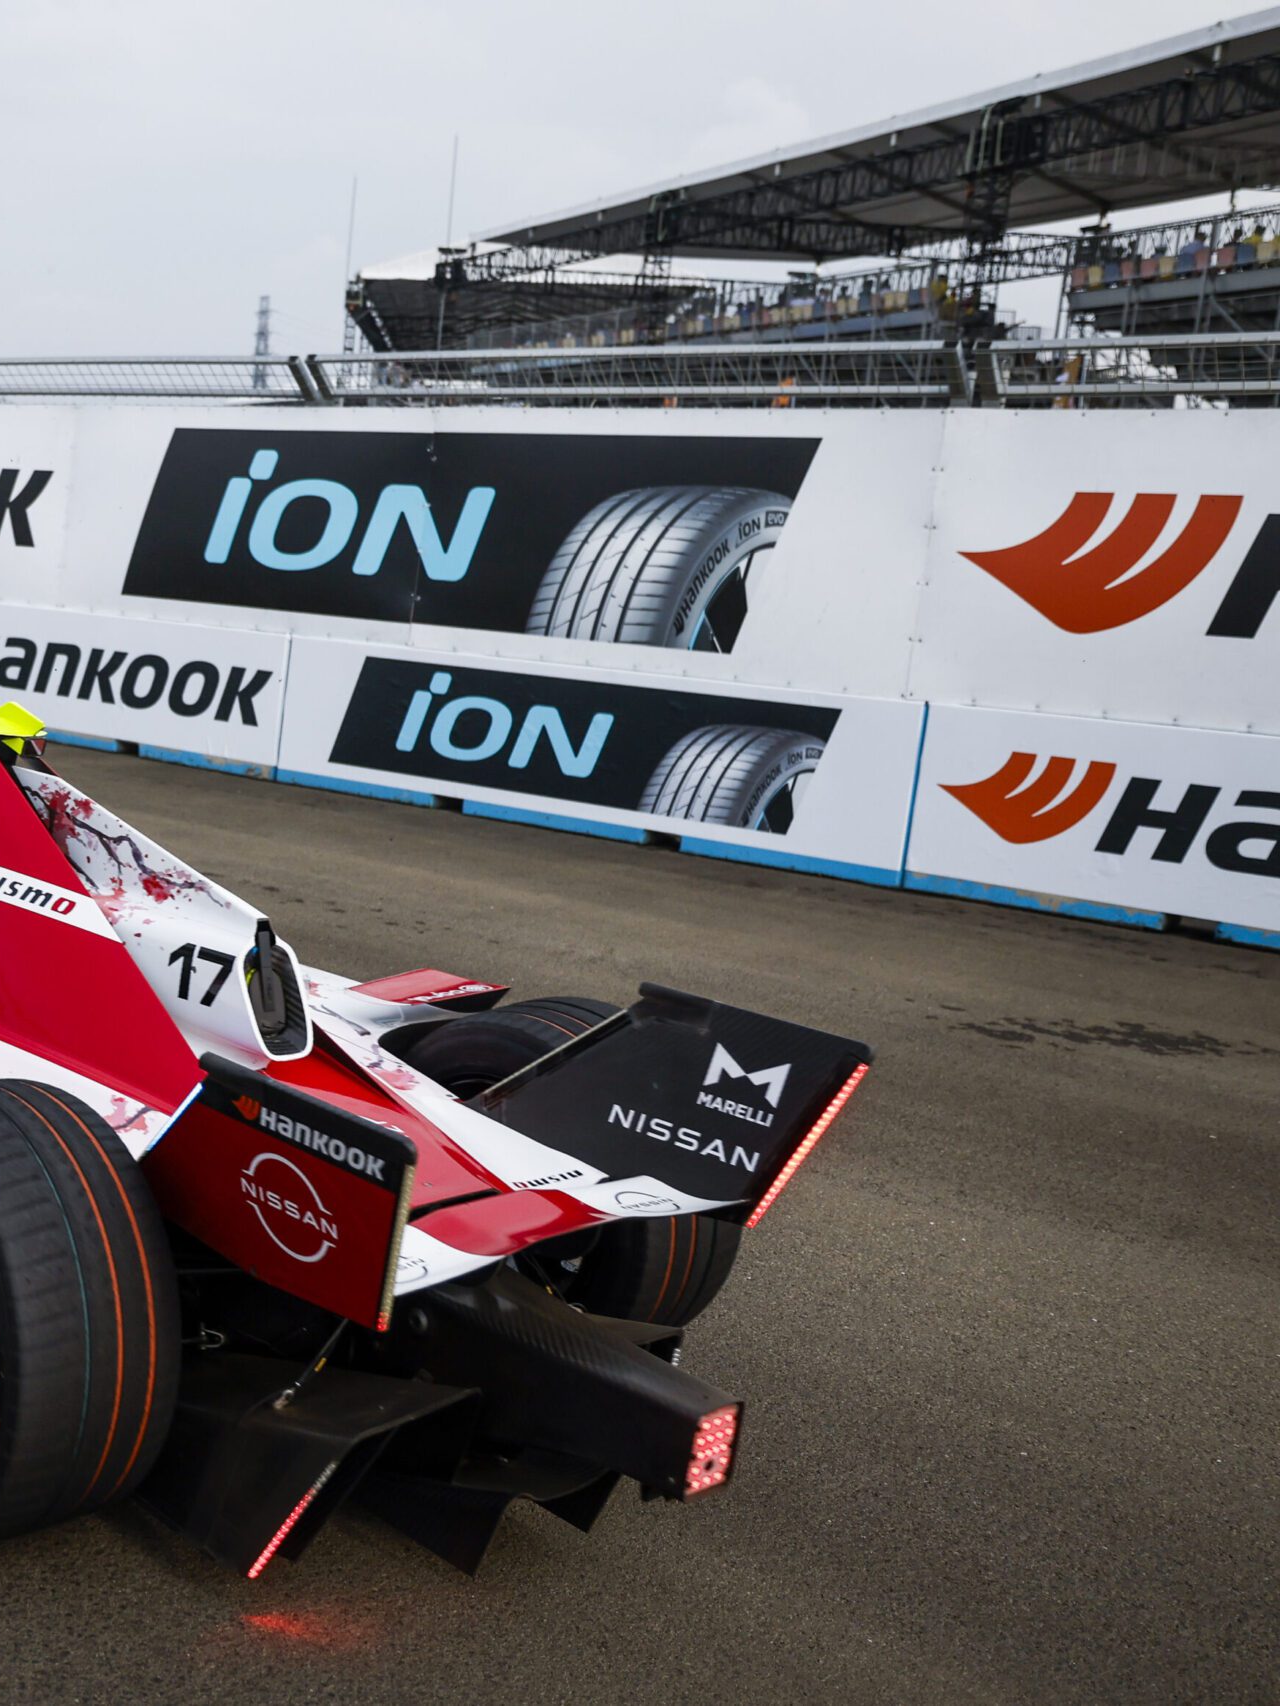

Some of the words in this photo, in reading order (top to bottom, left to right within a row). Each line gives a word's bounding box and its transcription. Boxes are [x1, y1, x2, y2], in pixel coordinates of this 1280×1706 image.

[204, 449, 496, 582] iON
[396, 671, 614, 778] iON
[168, 943, 236, 1007] 17
[608, 1104, 761, 1173] NISSAN
[697, 1091, 773, 1128] MARELLI
[240, 1177, 339, 1240] NISSAN
